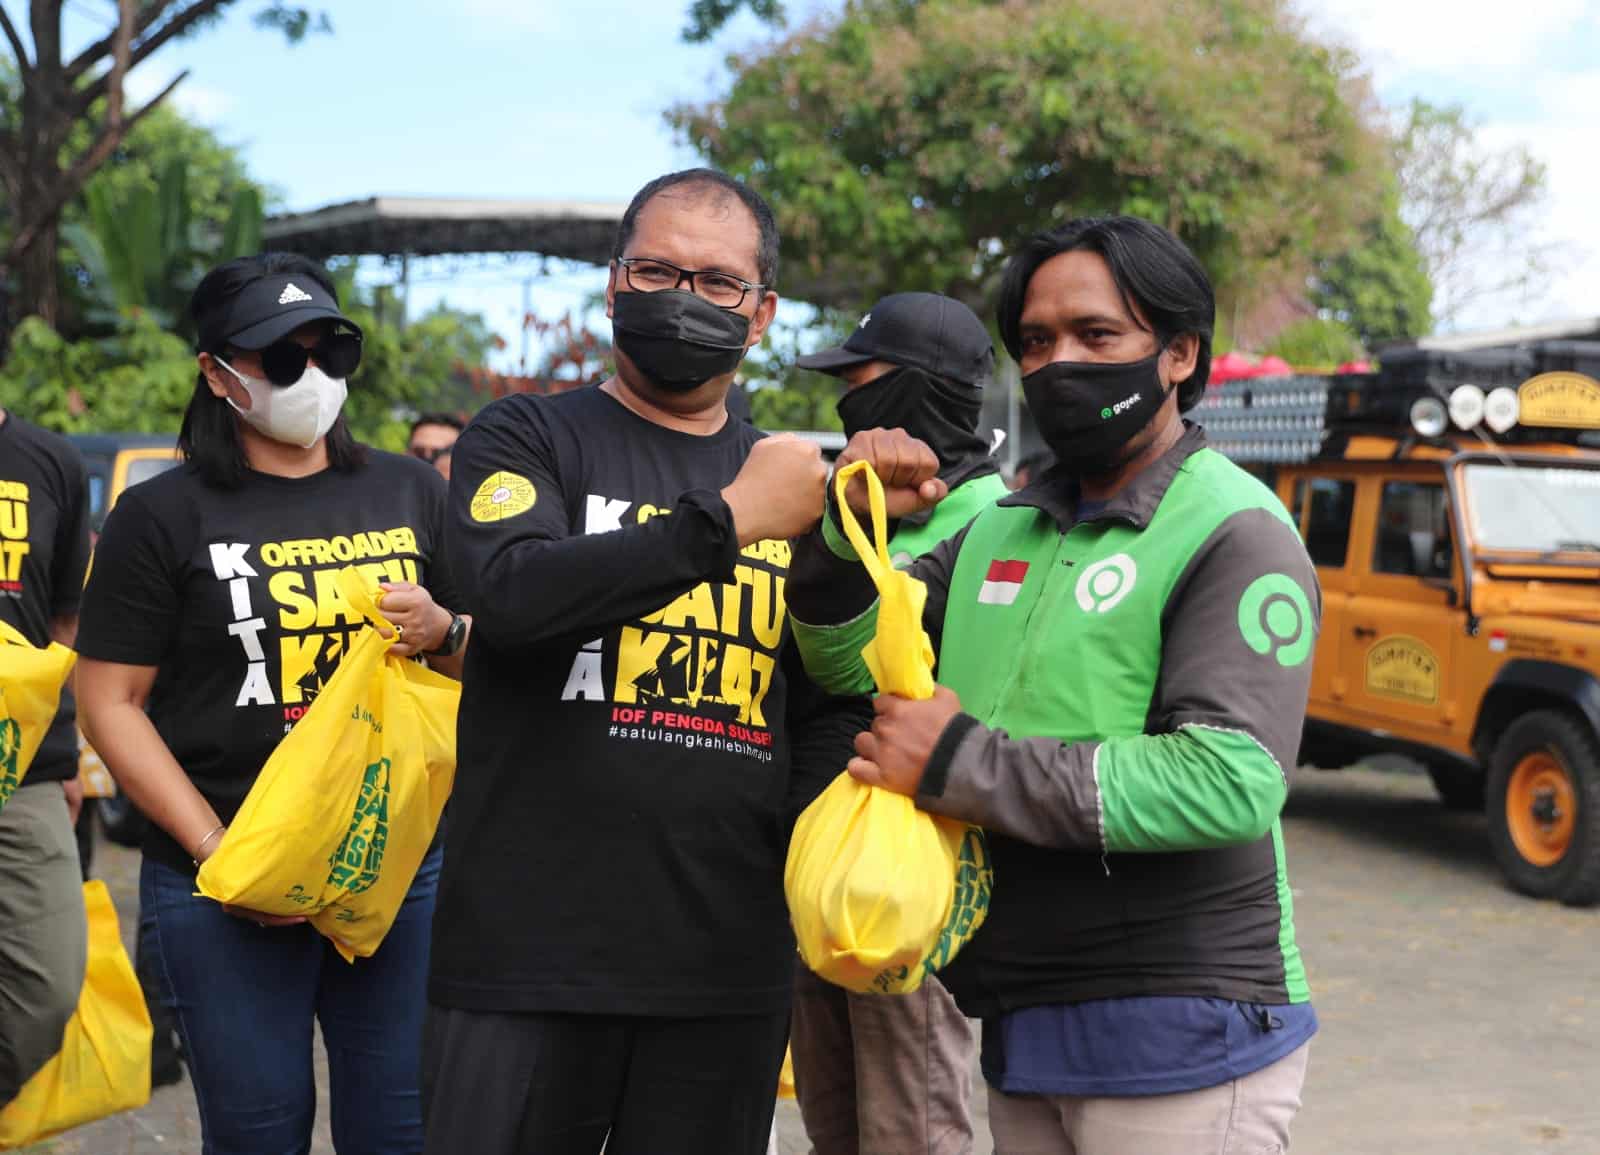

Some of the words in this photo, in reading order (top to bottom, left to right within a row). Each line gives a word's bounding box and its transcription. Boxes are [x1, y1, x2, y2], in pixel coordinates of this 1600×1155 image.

[1112, 392, 1142, 415] gojek
[639, 563, 787, 650] ATU
[611, 707, 647, 723] IOF
[651, 711, 725, 736] PENGDA
